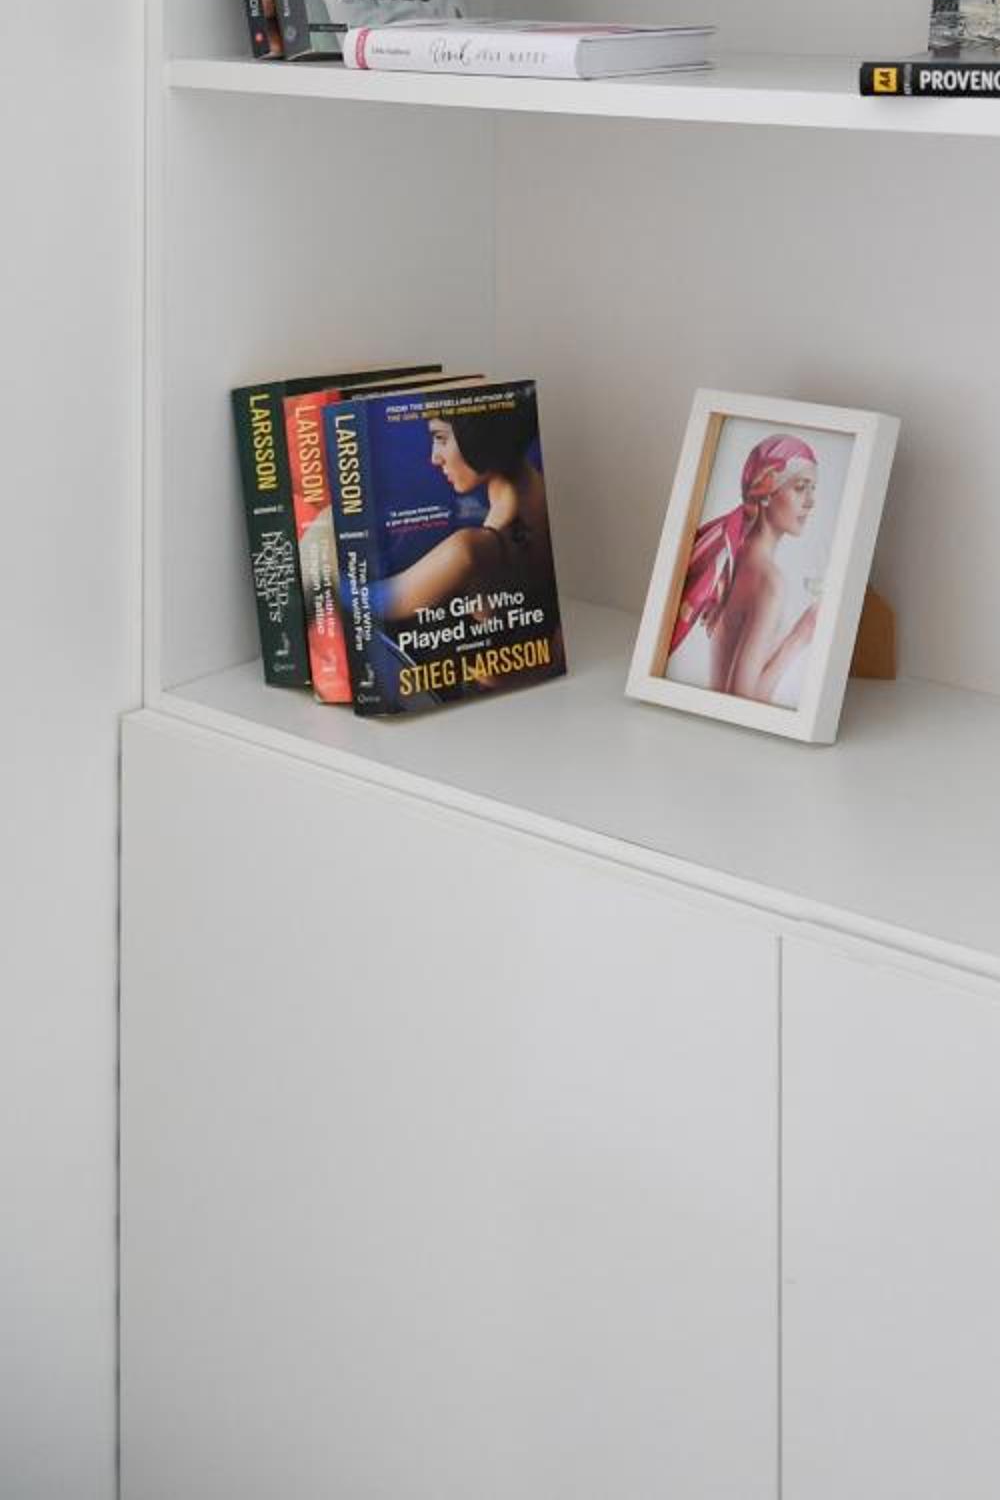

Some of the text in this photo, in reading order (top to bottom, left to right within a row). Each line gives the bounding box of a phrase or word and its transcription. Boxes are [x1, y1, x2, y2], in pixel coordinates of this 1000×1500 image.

[249, 393, 278, 490] LARSSON
[295, 405, 324, 505] LARSSON
[335, 414, 363, 515] LARSSON
[399, 620, 465, 653] Played
[470, 617, 503, 637] with
[507, 608, 544, 629] Fire
[415, 591, 524, 625] The Girl Who
[399, 637, 550, 696] STIEG LARSSON
